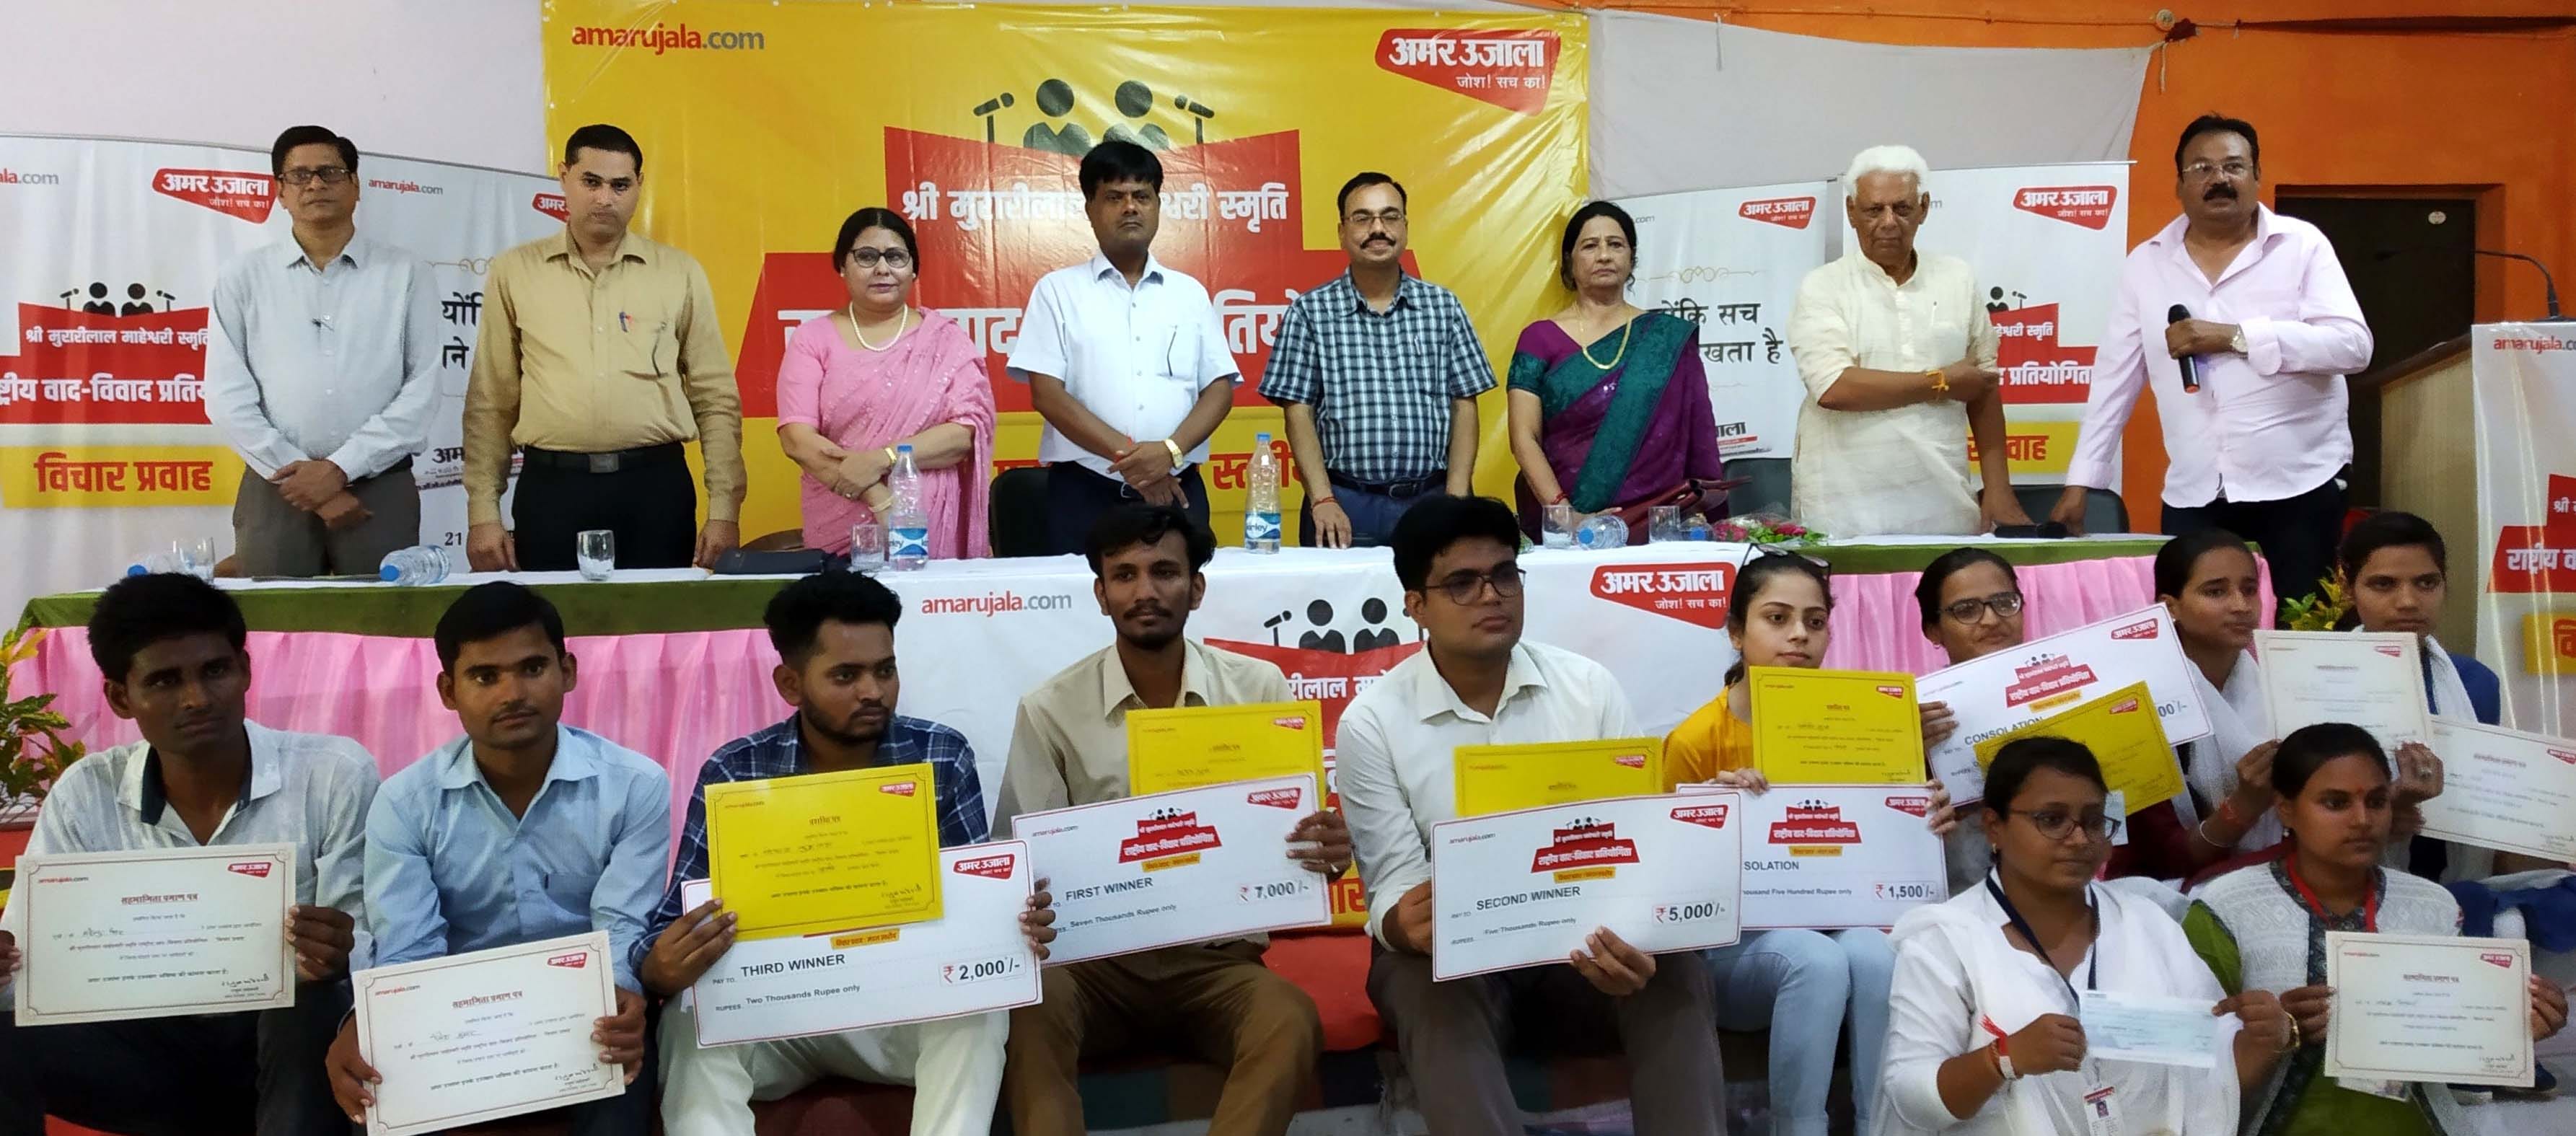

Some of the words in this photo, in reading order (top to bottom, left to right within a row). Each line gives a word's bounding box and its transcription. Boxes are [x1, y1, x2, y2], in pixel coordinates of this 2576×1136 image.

[571, 22, 765, 56] amarujala.com
[1389, 38, 1457, 66] अमर
[1459, 39, 1544, 67] उजाला
[1456, 73, 1490, 89] जोश!
[1495, 76, 1518, 88] सच
[1523, 75, 1545, 89] का!
[162, 173, 209, 193] अमर
[210, 175, 269, 196] उजाला
[369, 179, 443, 195] amarujala.com
[537, 196, 566, 211] अमर
[902, 182, 939, 221] श्री
[1218, 182, 1289, 232] स्मृति
[1744, 202, 1772, 216] अमर
[1772, 200, 1810, 213] उजाला
[2021, 190, 2060, 207] अमर
[2060, 189, 2108, 207] उजाला
[1718, 303, 1761, 325] सच
[26, 326, 43, 343] श्री
[48, 326, 116, 347] मुरारीलाल
[121, 327, 173, 345] माहेश्वरी
[2026, 322, 2054, 340] स्मृति
[1700, 340, 1755, 363] खता
[1762, 327, 1783, 364] है
[2009, 361, 2091, 386] प्रतियोगित
[41, 372, 154, 402] वाद-विवाद
[34, 452, 128, 492] विचार
[133, 462, 213, 492] प्रवाह
[2554, 496, 2569, 513] श्री
[444, 532, 462, 546] 21
[2506, 542, 2560, 574] राष्ट्रीय
[1601, 572, 1655, 594] अमर
[1656, 570, 1724, 593] उजाला
[922, 590, 1072, 617] amarujala.com
[1655, 596, 1682, 609] जोश!
[1686, 599, 1704, 609] सच
[1708, 596, 1726, 609] का!
[957, 860, 981, 871] अमर
[980, 857, 1010, 868] उजाला
[1744, 861, 1800, 871] SOLATION
[1065, 886, 1101, 901] FIRST
[1104, 876, 1153, 895] WINNER
[1477, 893, 1528, 910] SECOND
[1531, 886, 1581, 902] WINNER
[1070, 918, 1094, 928] Seven
[1095, 911, 1135, 923] Thousands
[1136, 907, 1159, 917] Rupee
[1161, 904, 1177, 913] only
[741, 962, 784, 977] THIRD
[788, 954, 845, 972] WINNER
[765, 990, 812, 1003] Thousands
[814, 987, 840, 998] Rupee
[843, 984, 860, 994] only
